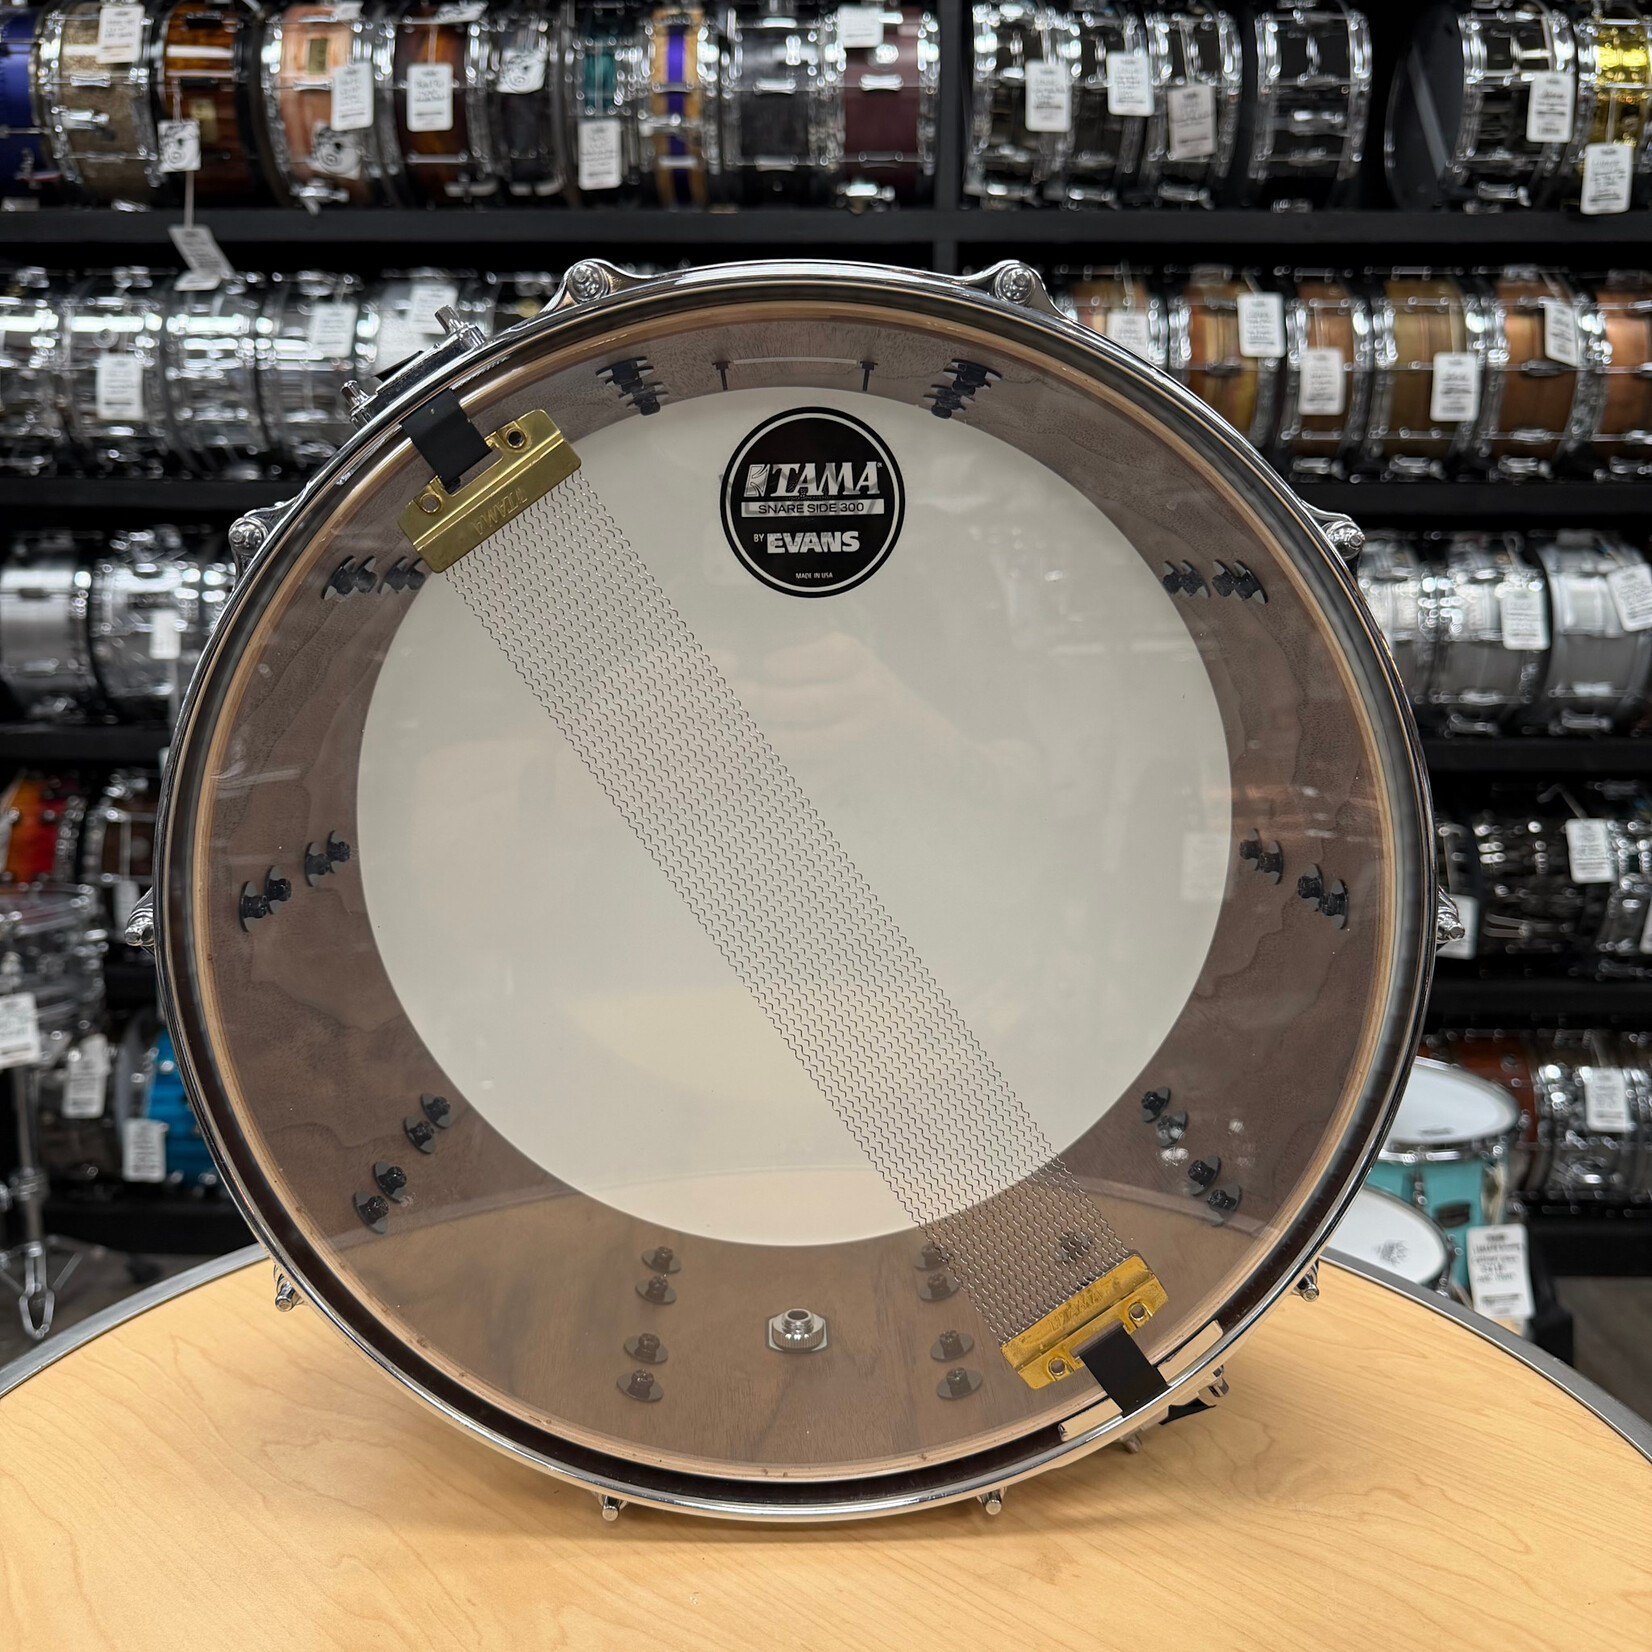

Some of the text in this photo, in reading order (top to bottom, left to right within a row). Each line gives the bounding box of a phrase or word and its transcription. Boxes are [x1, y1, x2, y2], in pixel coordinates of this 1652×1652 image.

[770, 461, 880, 496] TAMA
[758, 502, 864, 514] SNARE SIDE 300
[753, 531, 860, 553] BY EVANS
